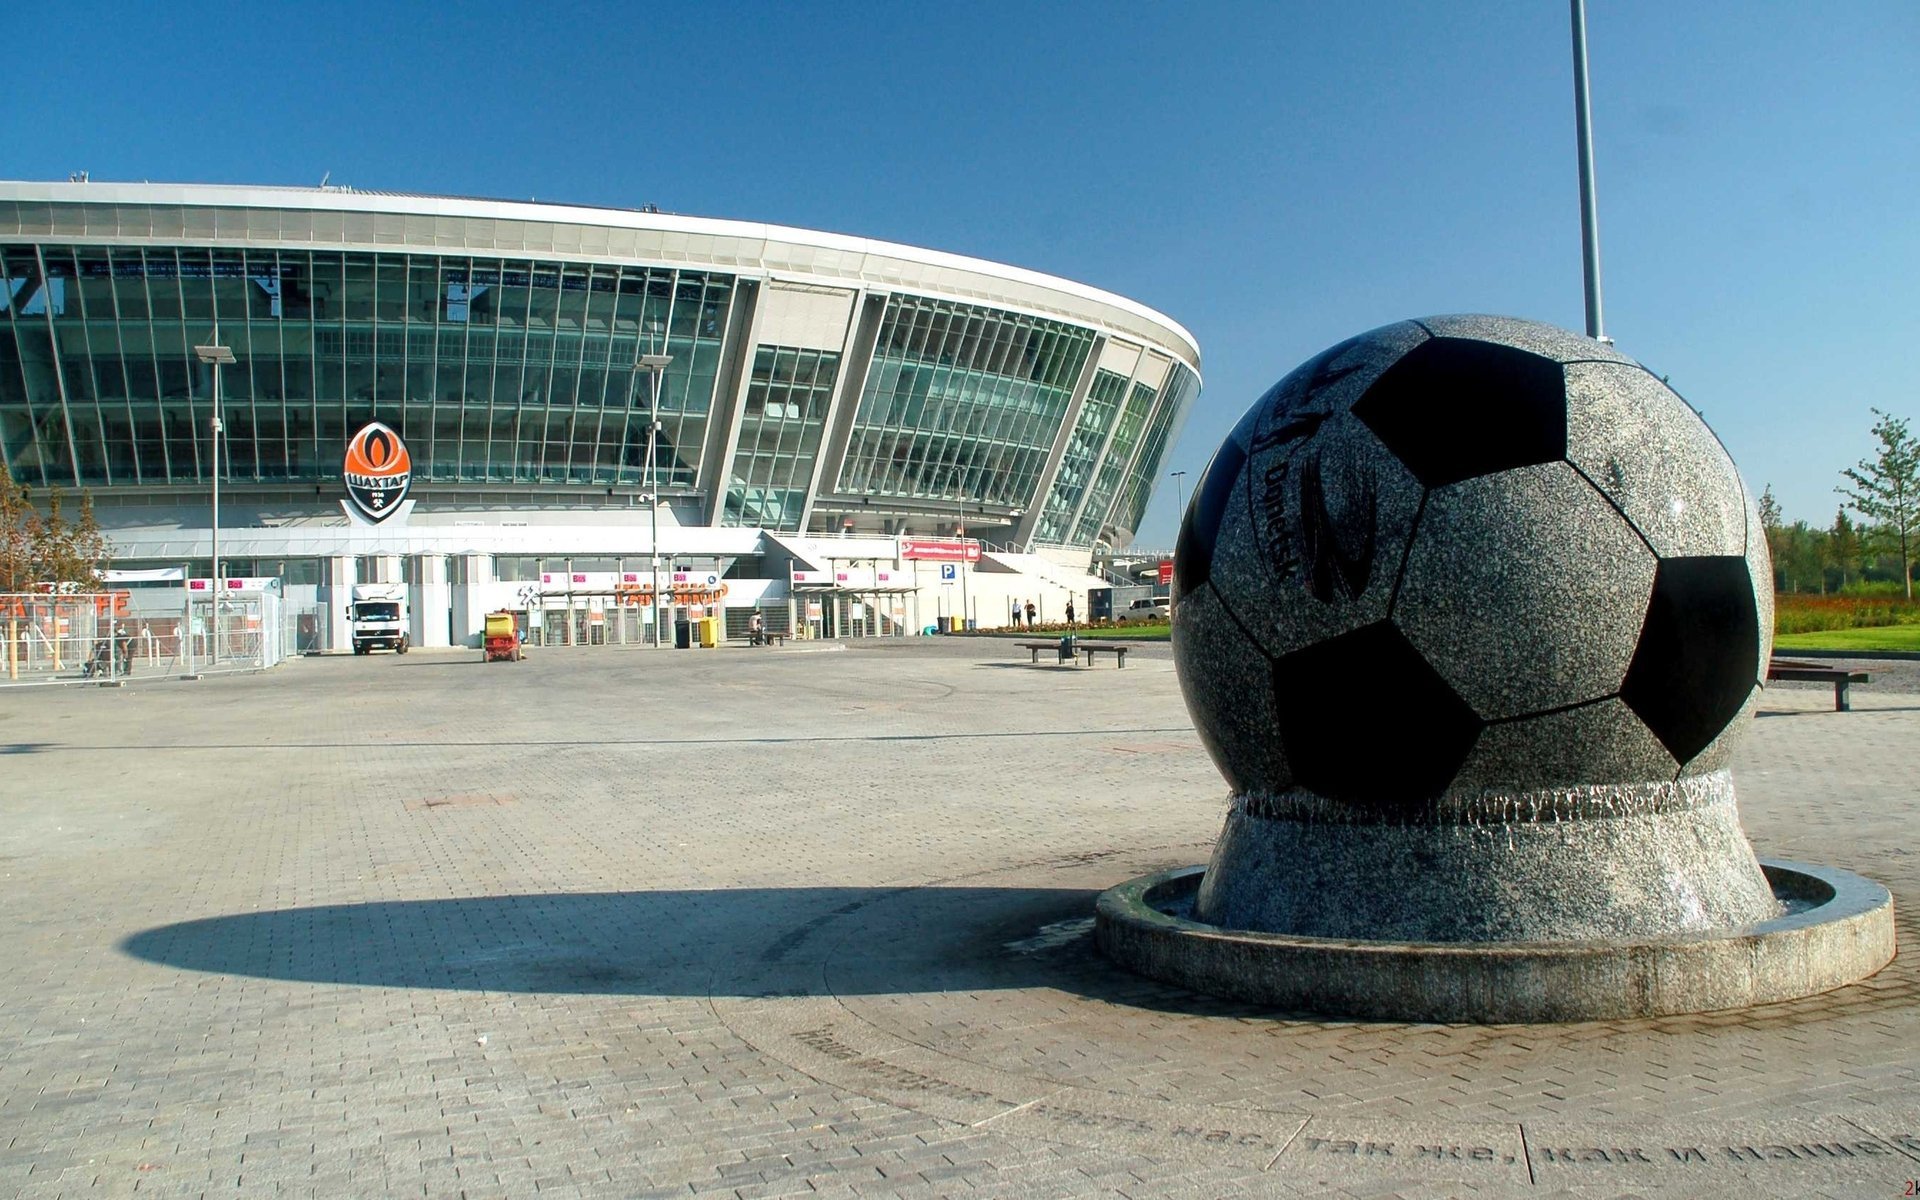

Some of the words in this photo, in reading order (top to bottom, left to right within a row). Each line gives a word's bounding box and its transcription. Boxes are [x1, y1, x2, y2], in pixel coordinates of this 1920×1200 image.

[348, 473, 408, 488] ШАХТАР
[1304, 1137, 1396, 1157] так
[1415, 1144, 1515, 1164] же,
[1540, 1148, 1651, 1163] как
[1666, 1147, 1707, 1162] и
